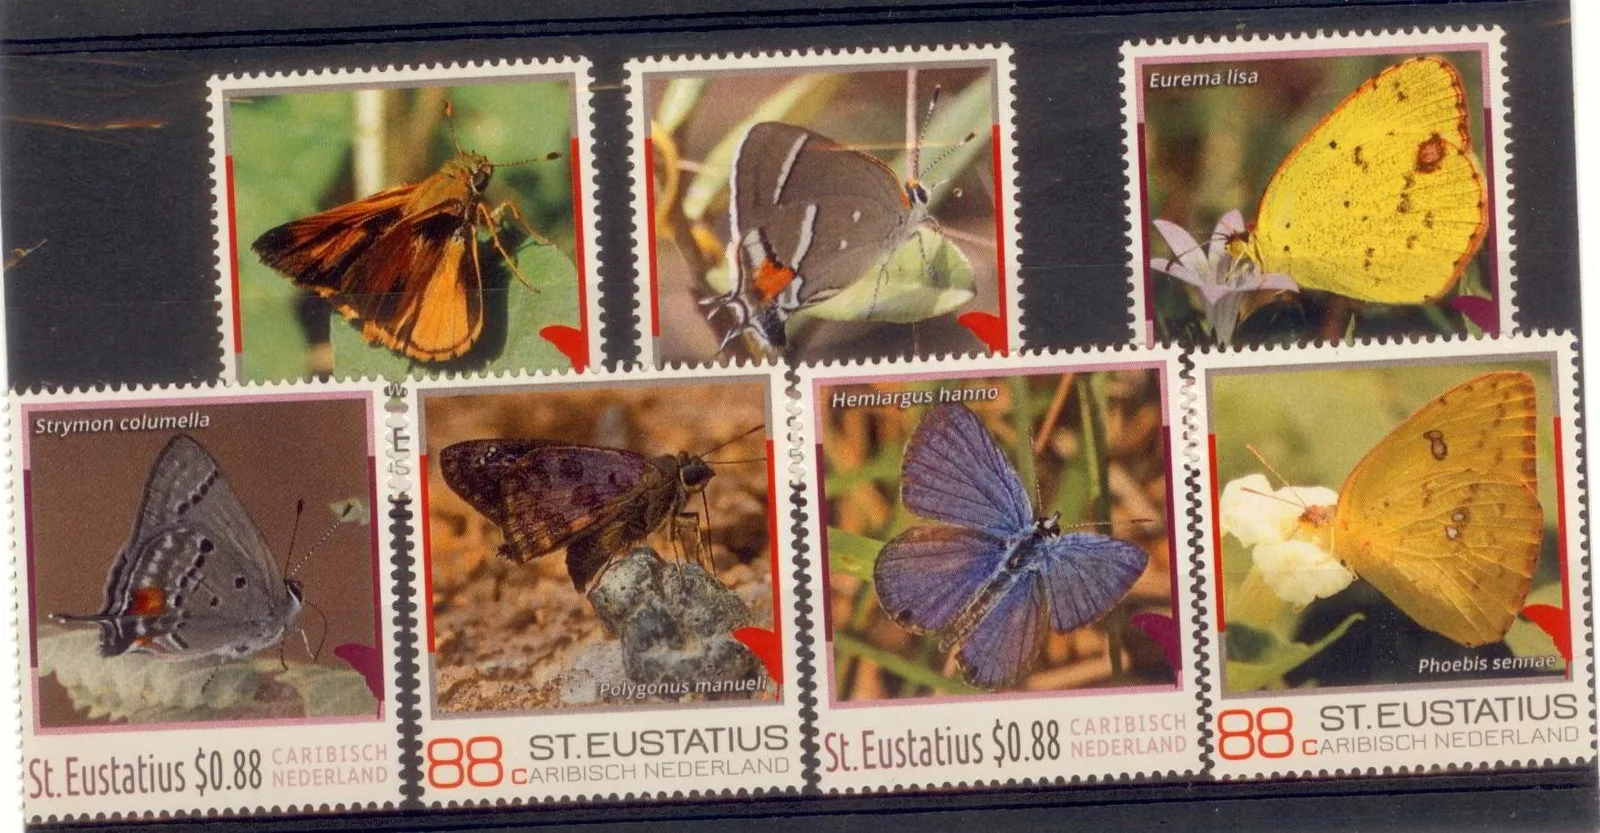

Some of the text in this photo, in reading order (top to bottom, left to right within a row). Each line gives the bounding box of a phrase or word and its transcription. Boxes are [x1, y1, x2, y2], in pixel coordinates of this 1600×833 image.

[1149, 67, 1259, 88] Eurema lisa
[832, 386, 999, 409] Hemiargus hanno
[35, 411, 211, 437] Strymon columella
[1418, 655, 1557, 674] Phoebis sennae
[599, 676, 767, 701] Polygonus manueli
[1070, 713, 1187, 737] CARIBISCH
[1217, 707, 1294, 760] 88
[992, 718, 1061, 769] $0.88
[1070, 735, 1188, 758] NEDERLAND
[1434, 726, 1579, 749] NEDERLAND
[272, 744, 388, 767] CARIBISCH
[427, 736, 503, 789] 88
[195, 747, 262, 797] $0.88
[272, 765, 388, 788] NEDERLAND
[644, 757, 790, 779] NEDERLAND
